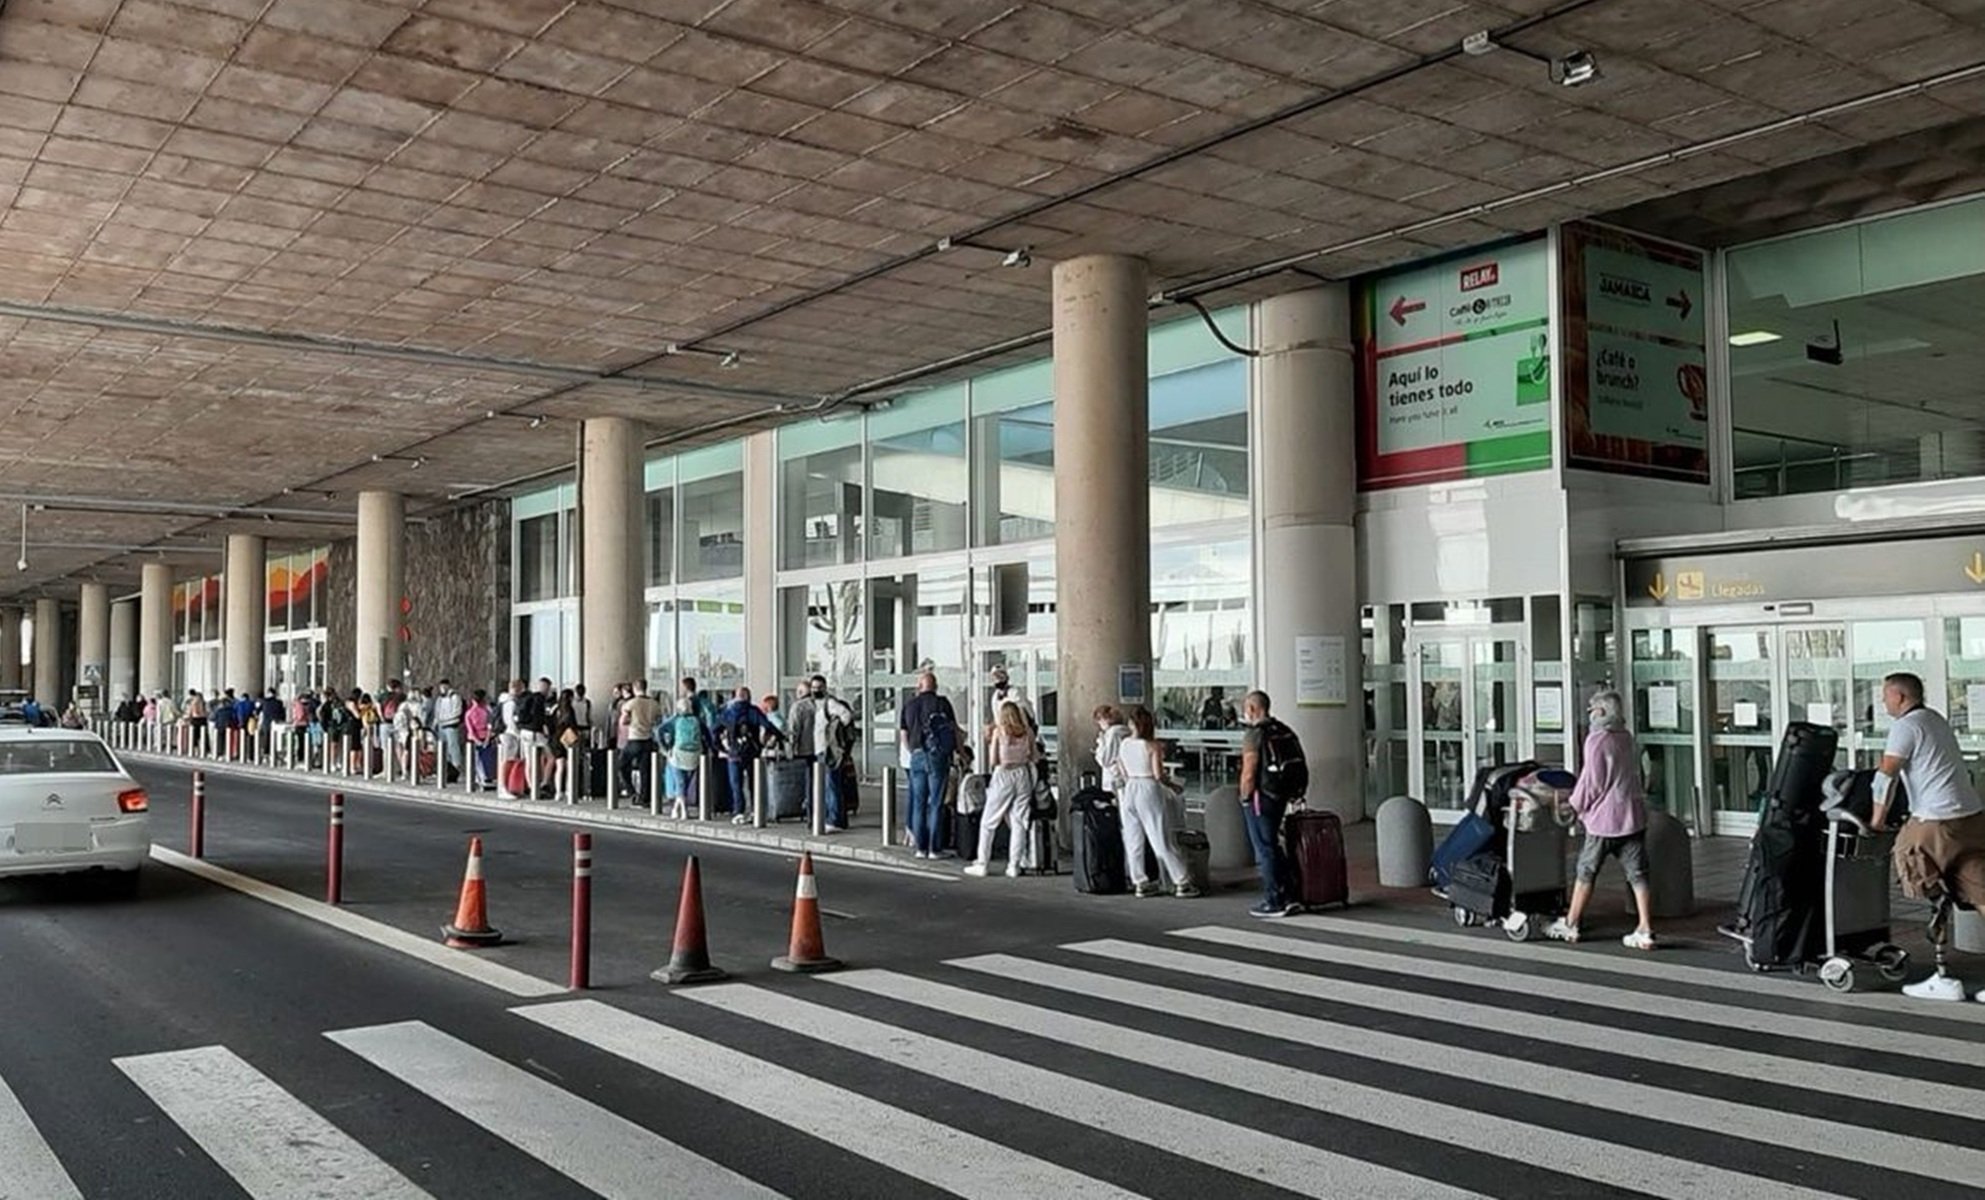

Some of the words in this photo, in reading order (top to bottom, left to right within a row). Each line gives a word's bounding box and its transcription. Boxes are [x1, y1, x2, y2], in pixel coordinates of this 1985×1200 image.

[1462, 266, 1495, 290] RELAY
[1389, 366, 1422, 388] Aquí
[1425, 366, 1439, 381] lo
[1389, 387, 1434, 406] tienes
[1439, 379, 1473, 398] todo
